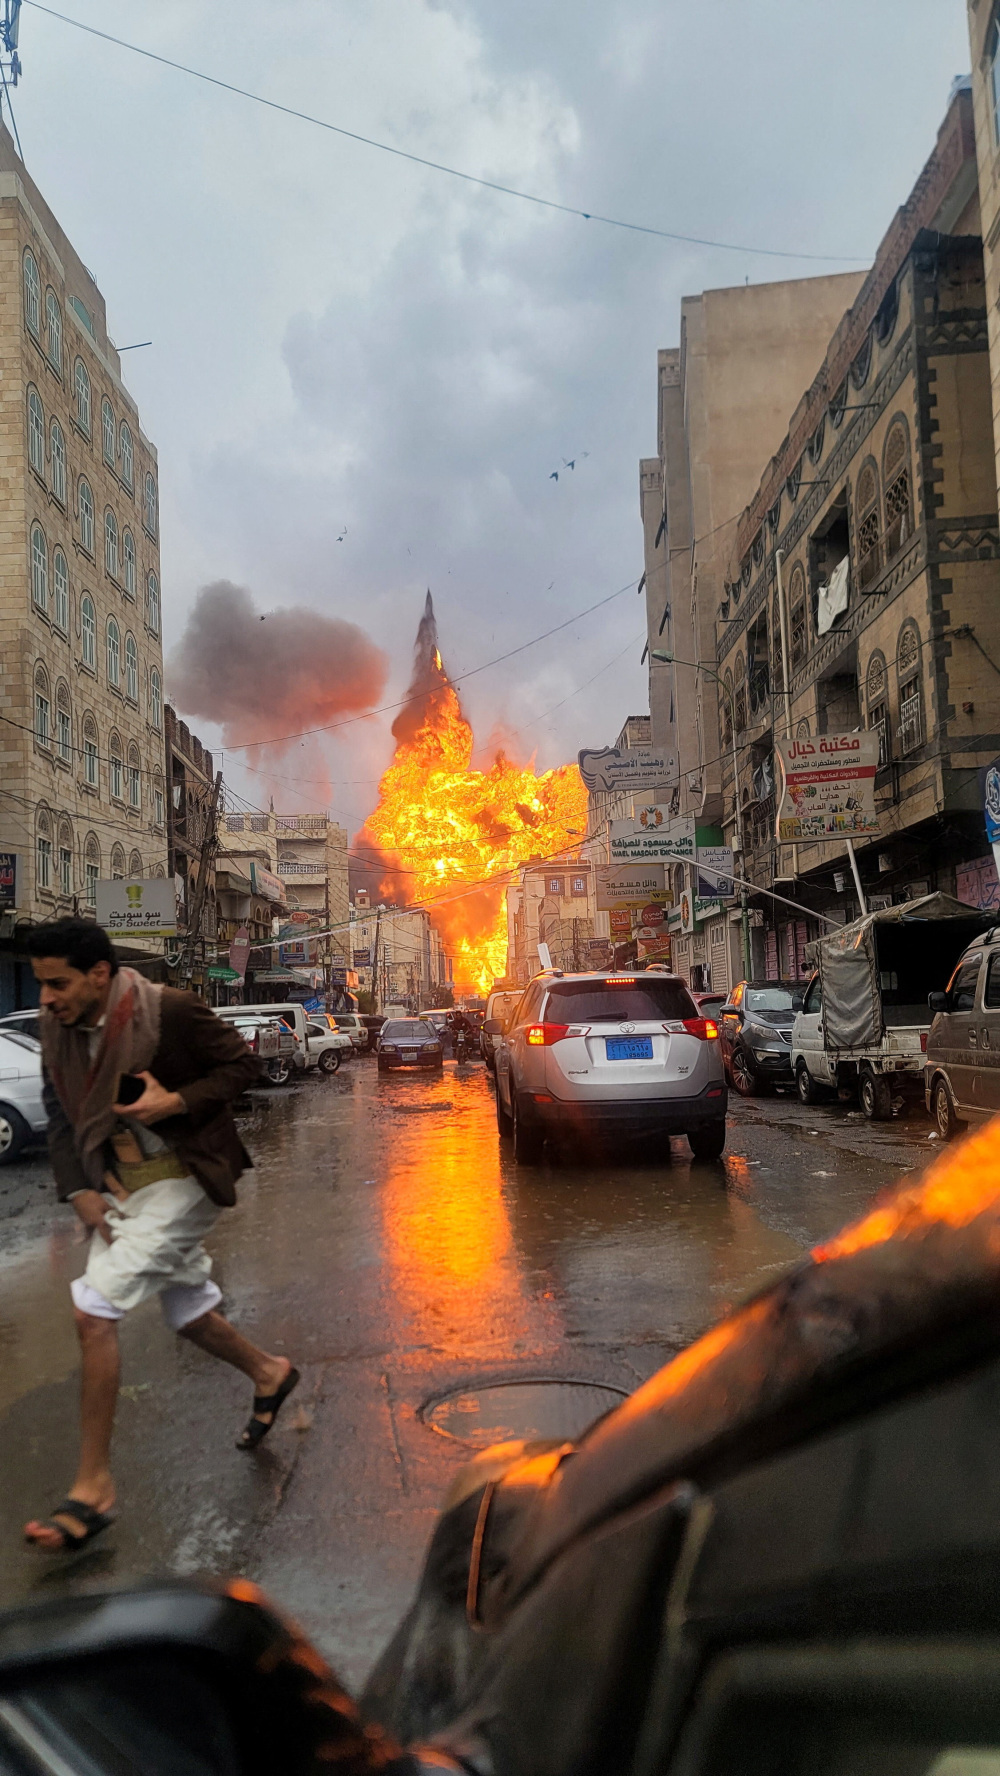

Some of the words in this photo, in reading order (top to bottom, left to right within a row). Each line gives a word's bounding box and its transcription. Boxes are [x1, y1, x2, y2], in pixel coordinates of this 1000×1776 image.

[788, 740, 816, 759] خيال
[820, 736, 860, 757] مكتبة
[791, 761, 810, 770] التجميل
[820, 792, 840, 802] هدايا
[612, 838, 640, 848] للصرافة
[675, 837, 693, 847] وائل
[606, 880, 640, 889] مسعود
[642, 880, 657, 888] وائل
[109, 911, 142, 922] سويت
[145, 912, 160, 920] سو
[126, 920, 161, 928] Sweet
